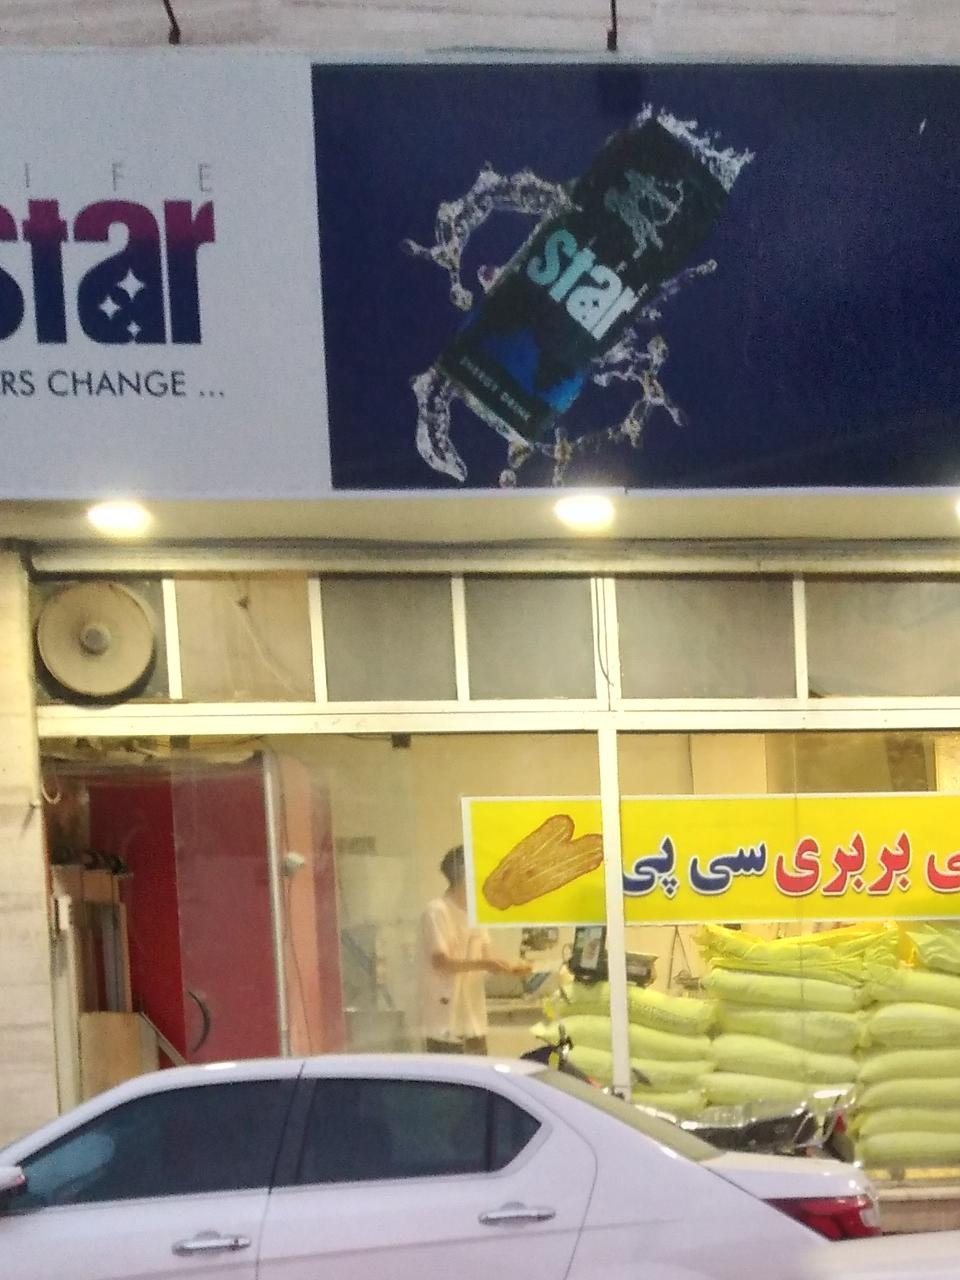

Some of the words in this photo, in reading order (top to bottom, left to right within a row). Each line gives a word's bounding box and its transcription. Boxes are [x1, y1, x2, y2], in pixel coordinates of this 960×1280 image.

[48, 370, 187, 398] CHANGE
[622, 834, 676, 898] پی
[689, 839, 767, 895] سی
[774, 829, 912, 895] بربری
